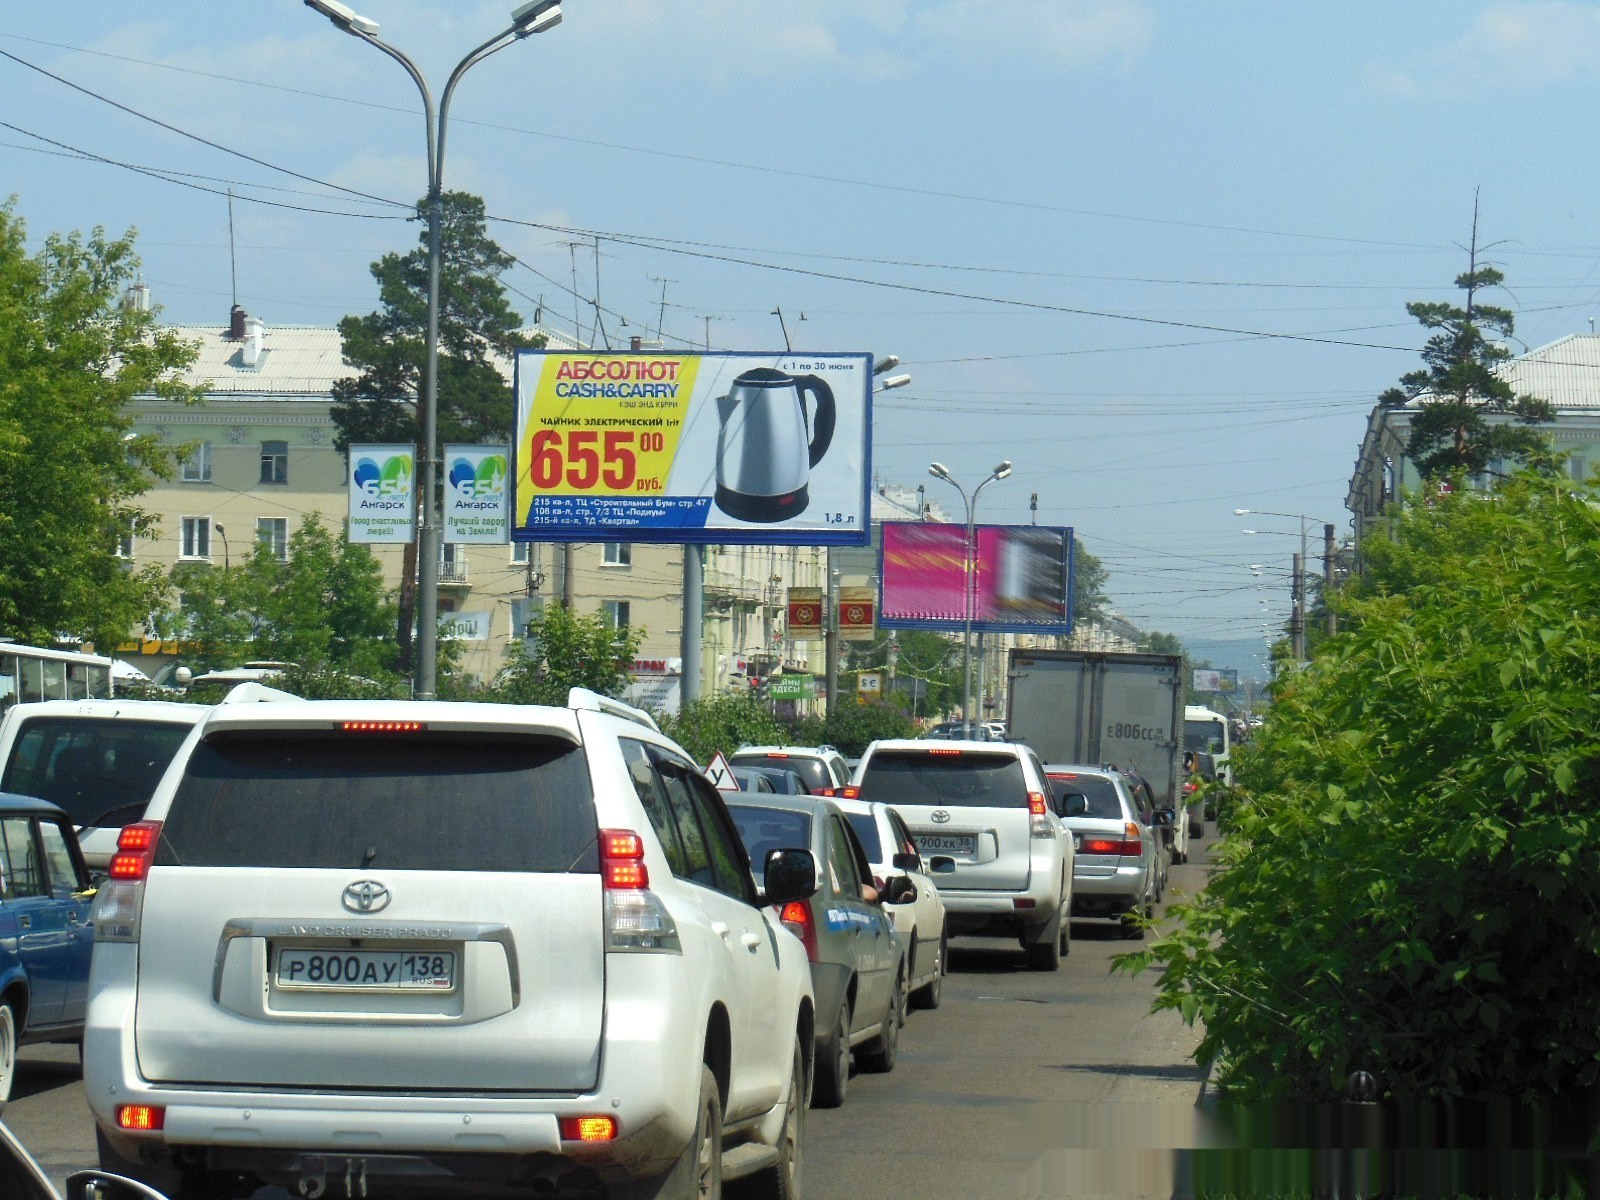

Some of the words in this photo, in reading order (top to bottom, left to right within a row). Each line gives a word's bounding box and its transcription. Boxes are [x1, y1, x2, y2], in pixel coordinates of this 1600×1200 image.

[556, 360, 680, 380] АБСОЛЮТ
[814, 362, 826, 370] 30
[556, 382, 680, 398] CASH&CARRY
[638, 401, 654, 409] ЭНД
[540, 417, 581, 426] ЧАЙНИК
[584, 417, 663, 426] ЭЛЕКТРИЧЕСКИЙ
[640, 432, 664, 452] 00
[530, 429, 636, 490] 655
[636, 477, 663, 491] руб.
[359, 500, 406, 510] Ангарск
[455, 500, 499, 510] Ангарск
[534, 498, 550, 506] 215
[576, 499, 588, 508] ТЦ
[696, 498, 707, 506] 47
[535, 507, 550, 515] 108
[576, 509, 592, 517] стр.
[595, 507, 609, 516] 7/3
[613, 507, 624, 517] ТЦ
[448, 516, 480, 526] Лучший
[482, 518, 506, 527] город
[598, 517, 640, 526] «Квартал»
[824, 512, 842, 524] 1,8
[847, 515, 854, 523] л
[457, 527, 466, 535] на
[468, 527, 498, 535] Земле!
[772, 685, 800, 694] ЗДЕСЬ!
[1107, 722, 1153, 741] Е806СС
[278, 925, 320, 937] LAND
[324, 925, 393, 938] CRUISER
[399, 926, 452, 938] PRADO
[290, 955, 398, 983] Р800АУ
[404, 955, 444, 977] 138
[411, 976, 433, 985] RUS
